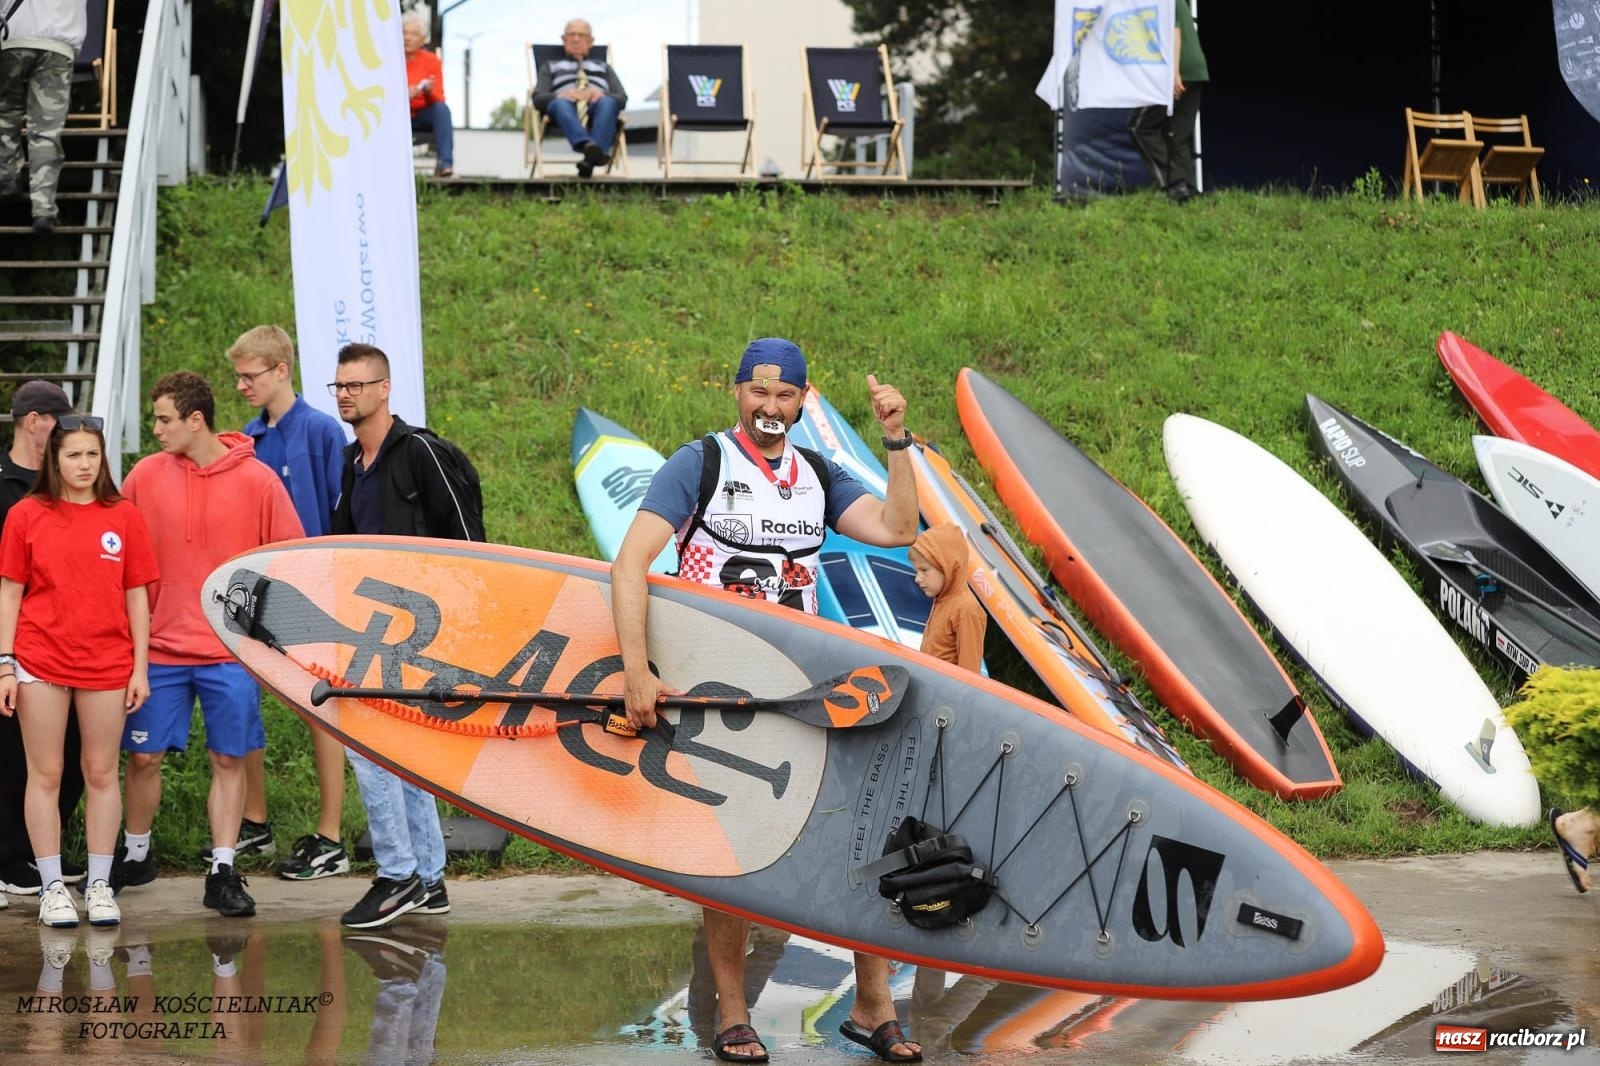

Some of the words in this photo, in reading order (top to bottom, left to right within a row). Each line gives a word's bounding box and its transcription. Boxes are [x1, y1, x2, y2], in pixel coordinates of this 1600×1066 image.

[1507, 466, 1544, 499] SIC
[903, 736, 916, 776] FEEL
[853, 823, 867, 861] FEEL
[861, 786, 876, 816] THE
[870, 743, 889, 783] BASS
[895, 780, 910, 812] THE
